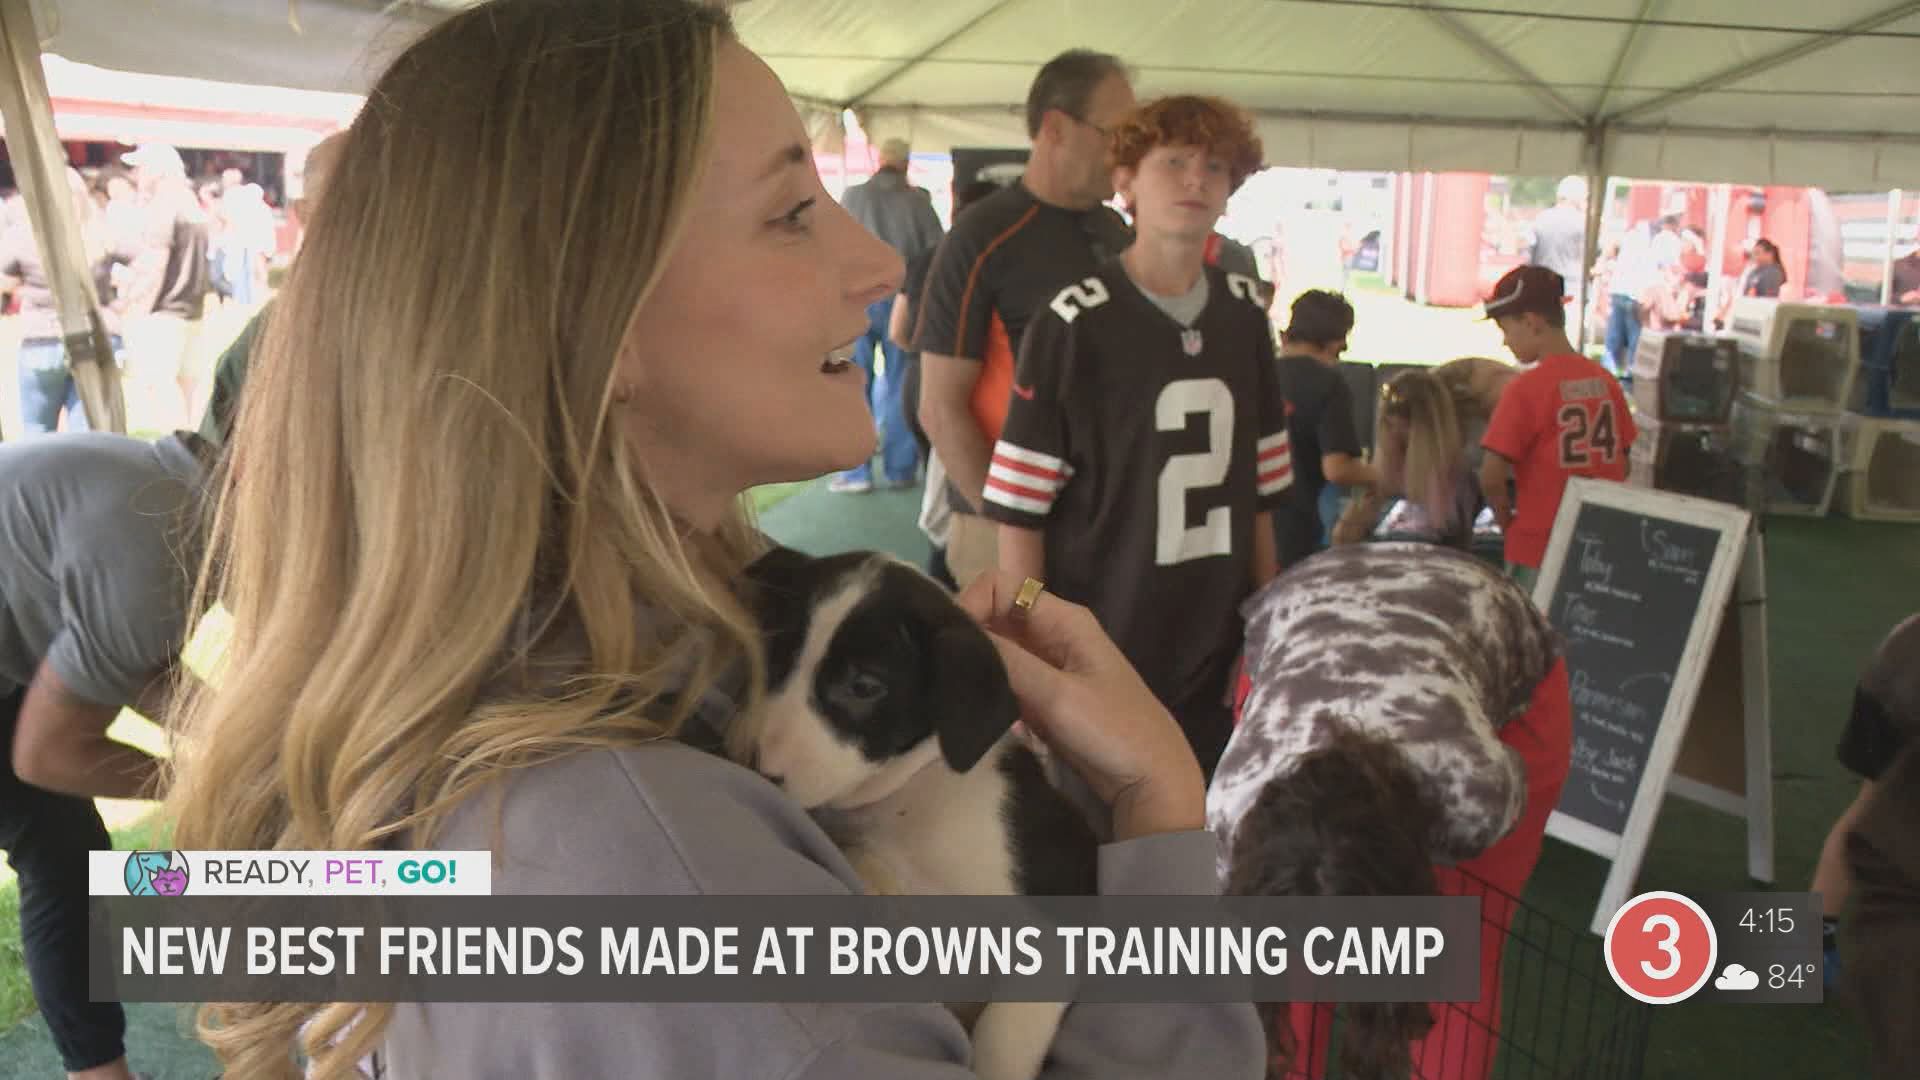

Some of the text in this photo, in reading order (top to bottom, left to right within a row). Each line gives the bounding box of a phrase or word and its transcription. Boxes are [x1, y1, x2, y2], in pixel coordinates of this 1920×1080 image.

[1050, 277, 1110, 324] 2
[1557, 399, 1618, 468] 24
[1155, 377, 1236, 566] 2
